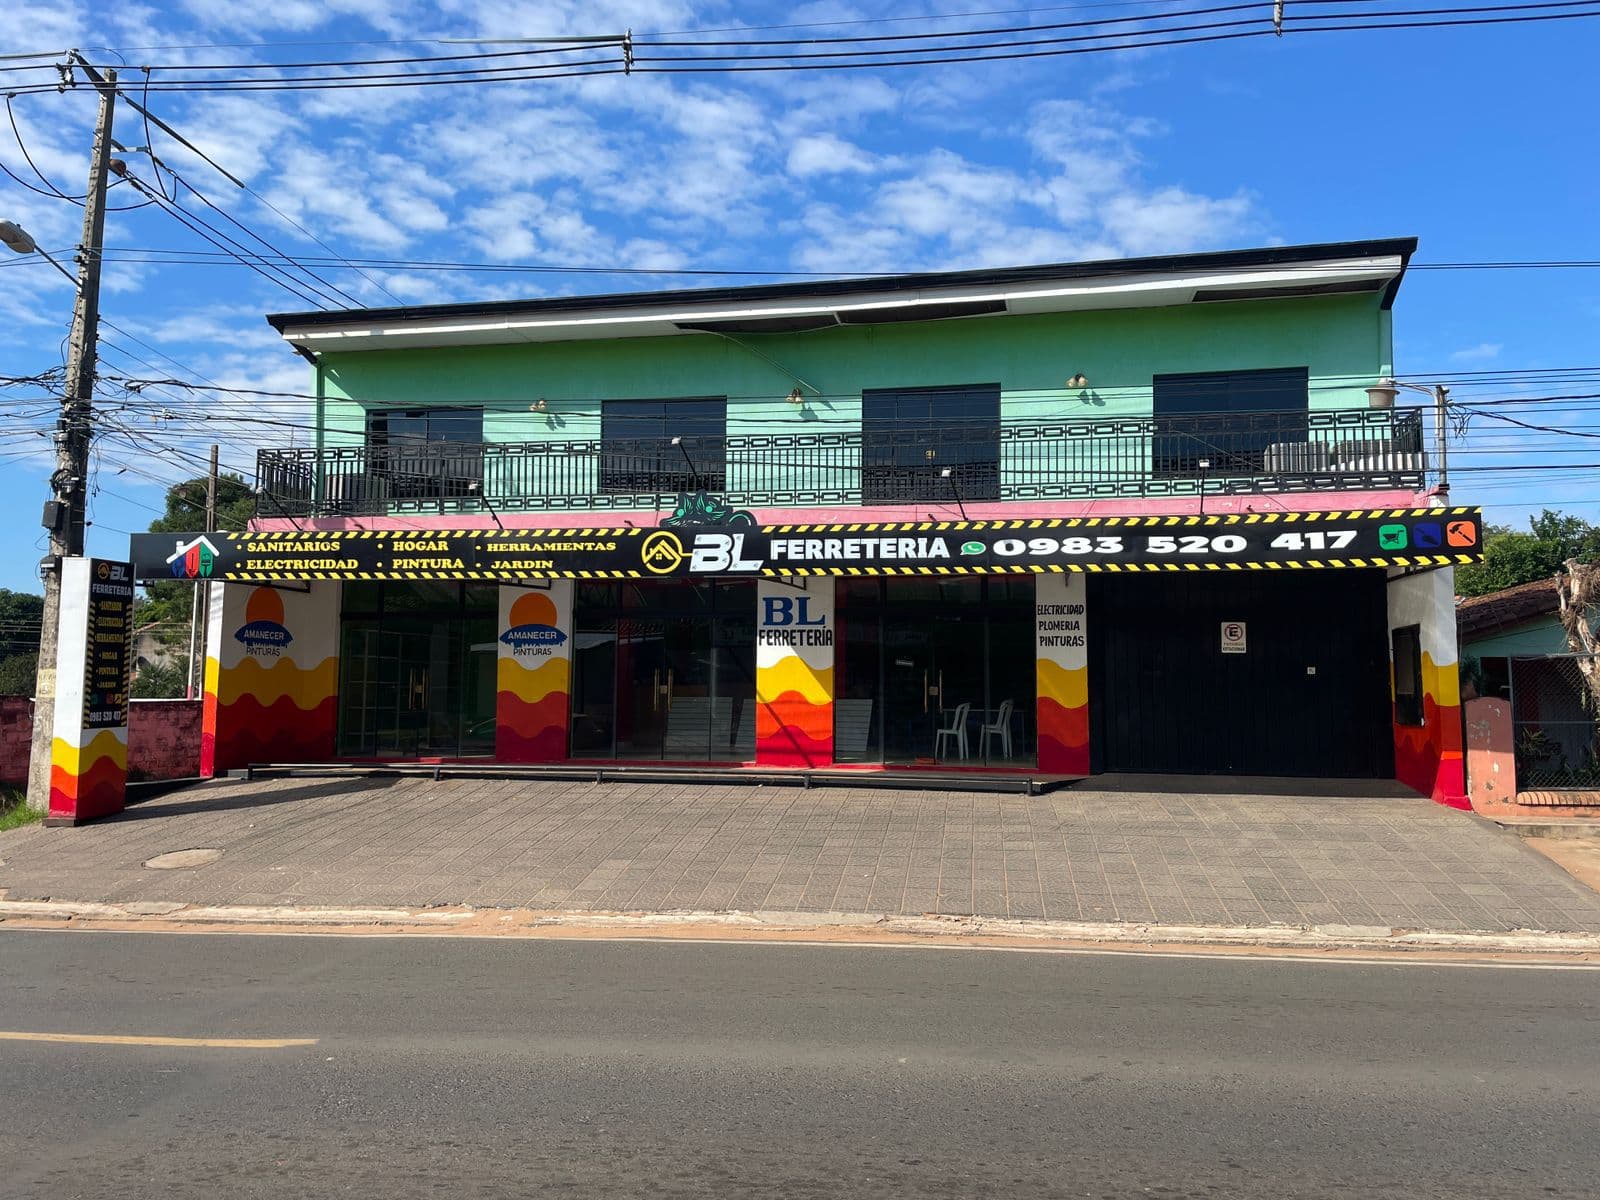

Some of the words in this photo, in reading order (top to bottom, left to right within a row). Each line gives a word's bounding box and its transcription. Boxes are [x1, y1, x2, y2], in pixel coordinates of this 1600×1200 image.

[247, 541, 340, 552] SANITARIOS
[393, 541, 449, 551] HOGAR
[487, 542, 617, 552] HERRAMIENTAS
[770, 537, 950, 561] FERRETERIA
[993, 535, 1123, 557] 0983
[1145, 533, 1247, 555] 520
[1270, 530, 1358, 551] 417
[689, 533, 763, 573] BL
[246, 559, 358, 570] ELECTRICIDAD
[392, 558, 464, 570] PINTURA
[491, 560, 553, 569] JARDIN
[110, 565, 129, 581] BL
[92, 584, 132, 596] FERRETERIA
[762, 597, 826, 626] BL
[1037, 604, 1085, 615] ELECTRICIDAD
[1038, 620, 1081, 631] PLOMERIA
[243, 630, 284, 640] AMANECER
[508, 632, 557, 640] AMANECER
[759, 626, 833, 646] FERRETERÍA
[1039, 635, 1085, 647] PINTURAS
[246, 646, 281, 656] PINTURAS
[513, 648, 552, 656] PINTURAS
